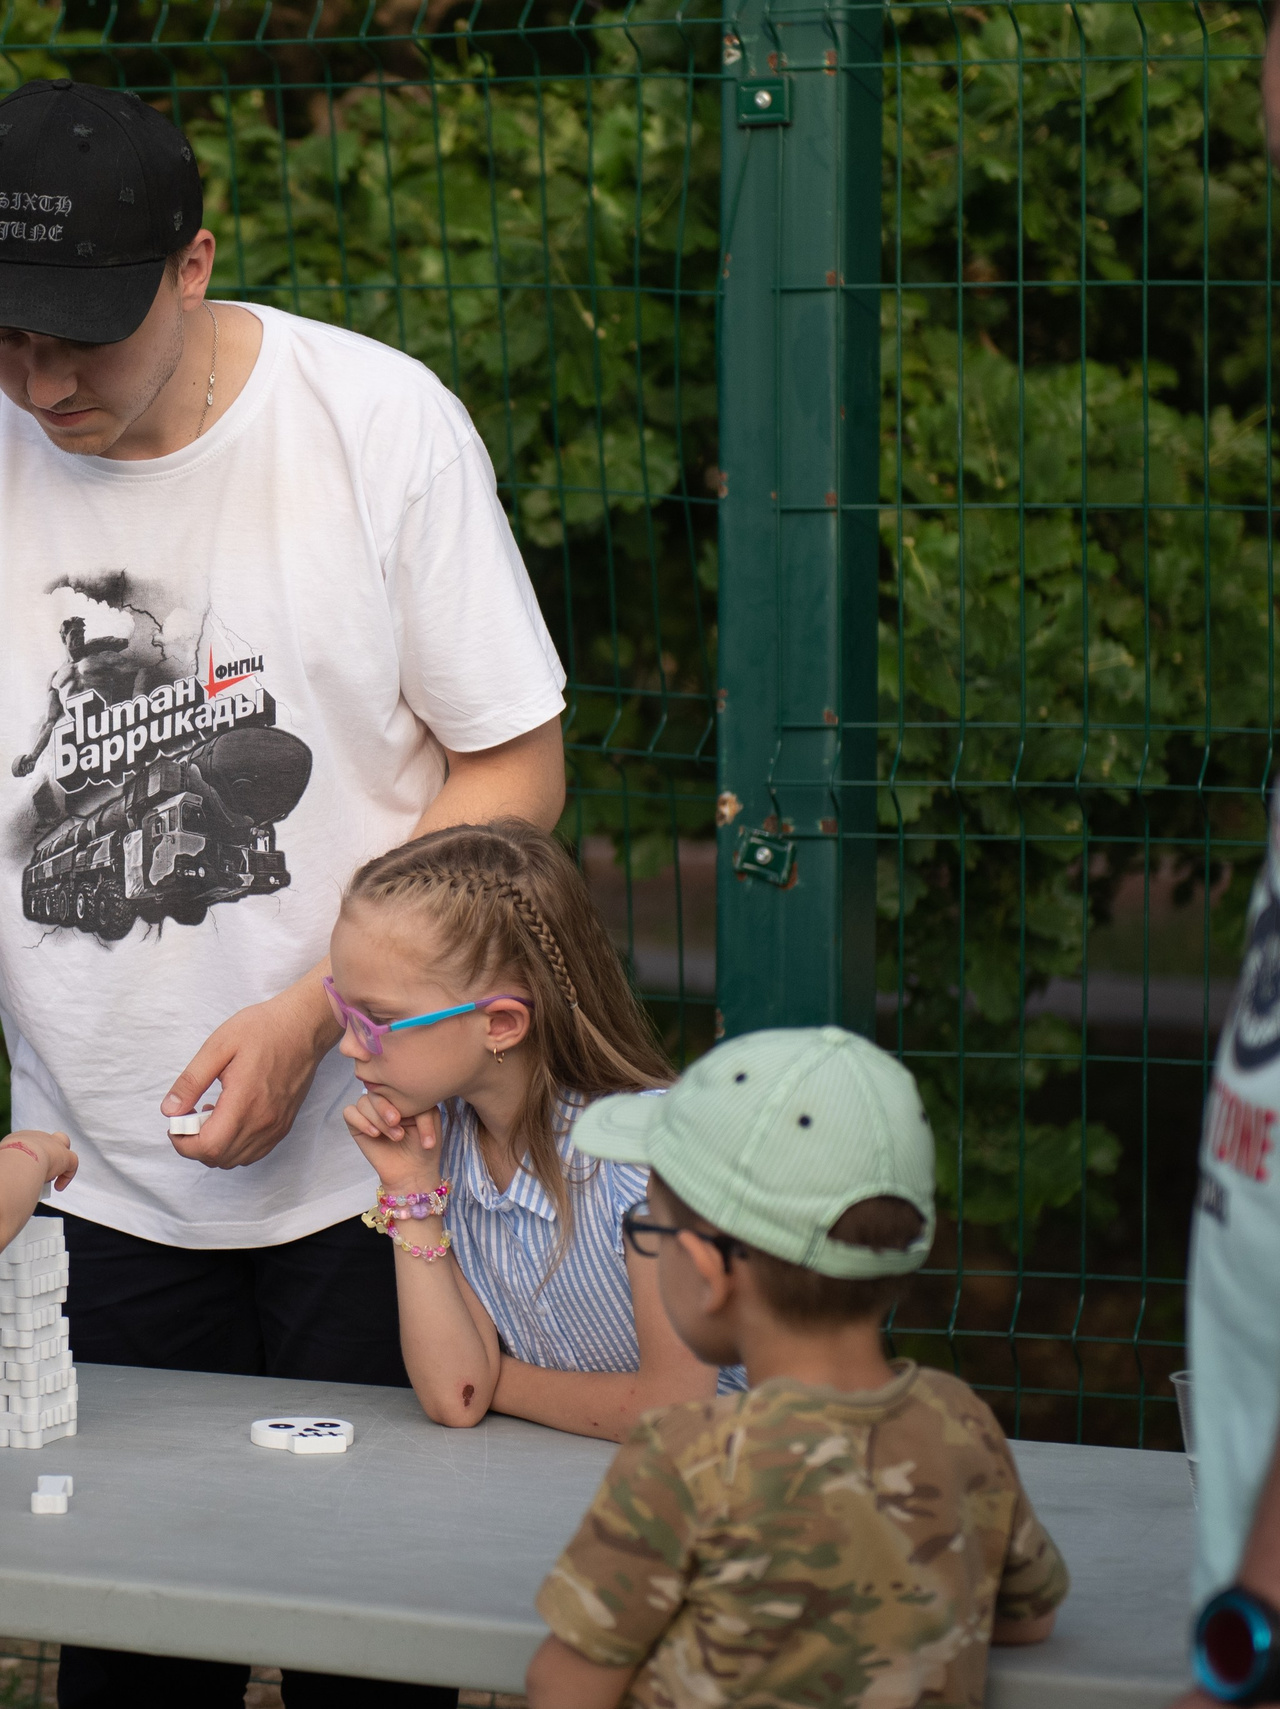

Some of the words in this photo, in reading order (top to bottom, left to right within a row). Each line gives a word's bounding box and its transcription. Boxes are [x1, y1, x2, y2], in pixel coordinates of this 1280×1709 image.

[214, 655, 265, 680] ФНПЦ
[54, 688, 266, 780] Баррикады
[65, 677, 197, 745] Титан
